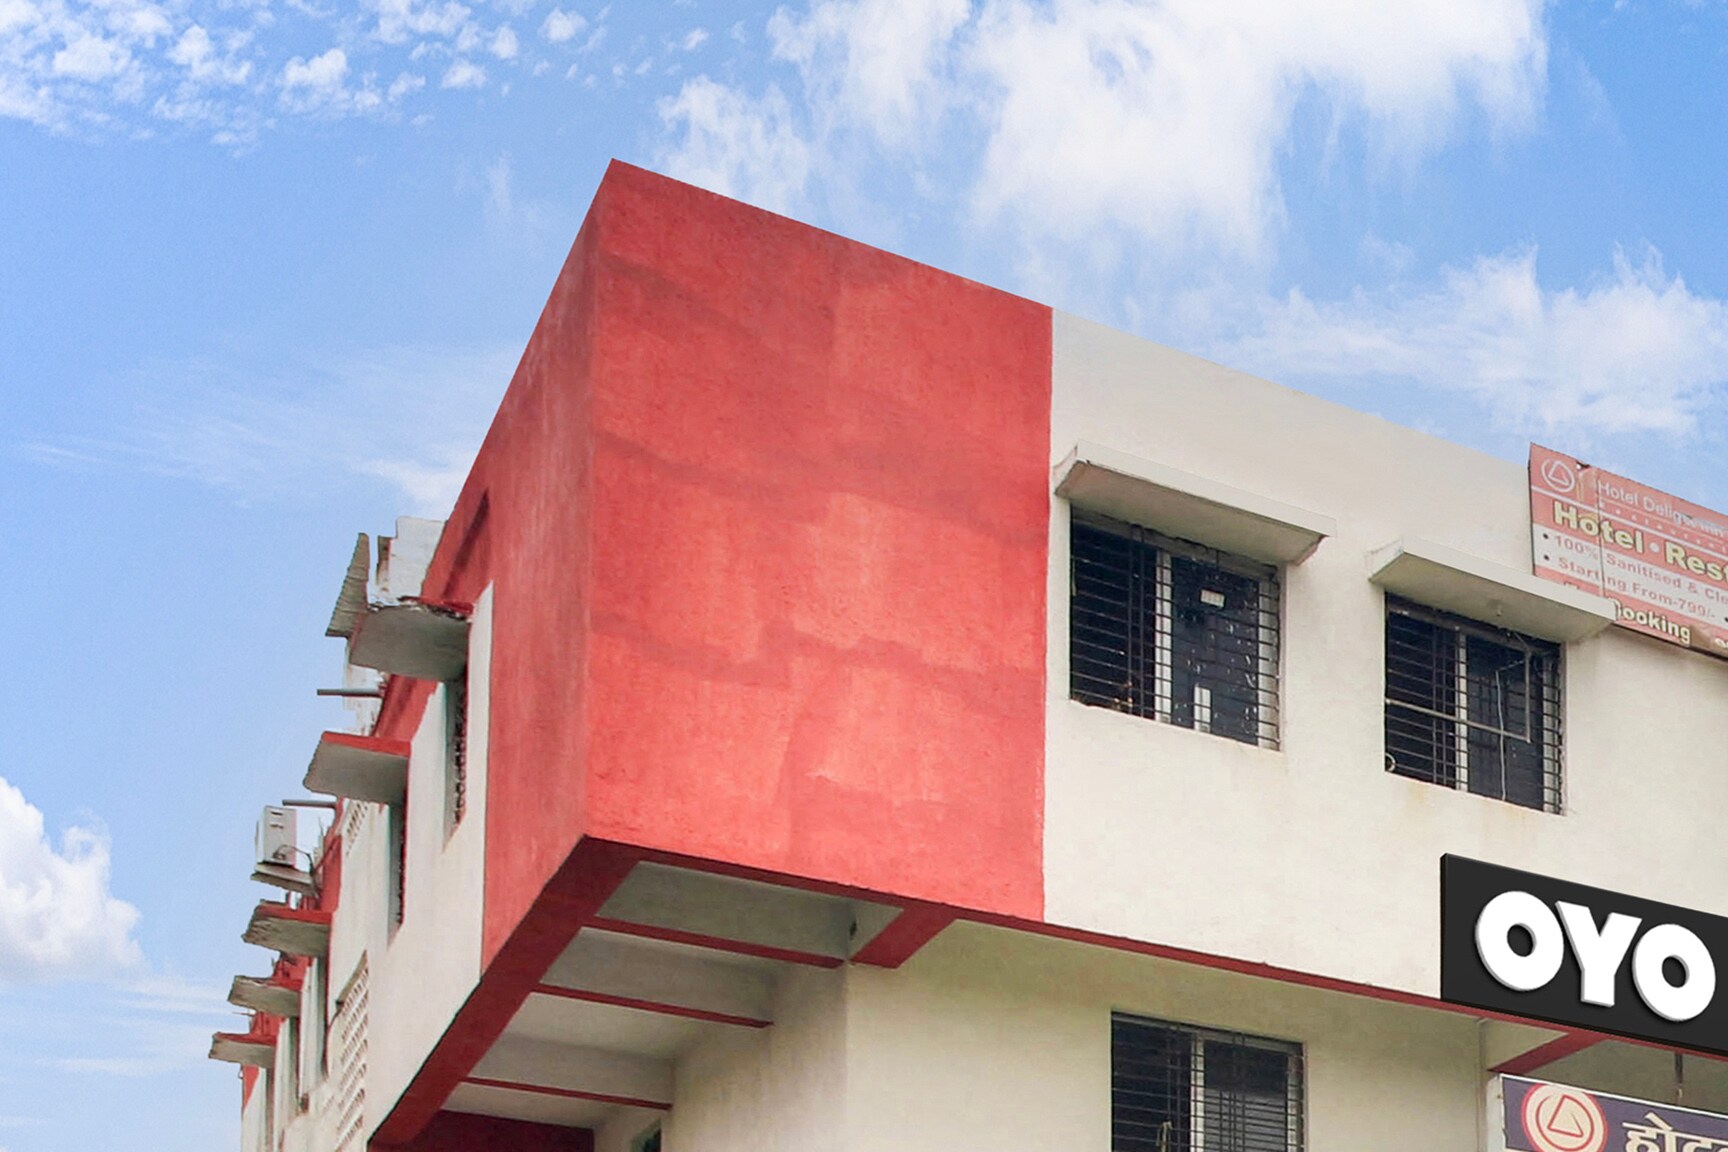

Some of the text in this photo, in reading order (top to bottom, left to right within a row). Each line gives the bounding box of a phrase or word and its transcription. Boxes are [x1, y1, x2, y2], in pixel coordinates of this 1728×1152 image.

[1598, 479, 1639, 503] Hotel
[1552, 500, 1645, 554] Hotel
[1554, 534, 1599, 561] 100%
[1606, 552, 1682, 589] Sanitised
[1687, 582, 1699, 595] &
[1474, 890, 1717, 1022] OYO
